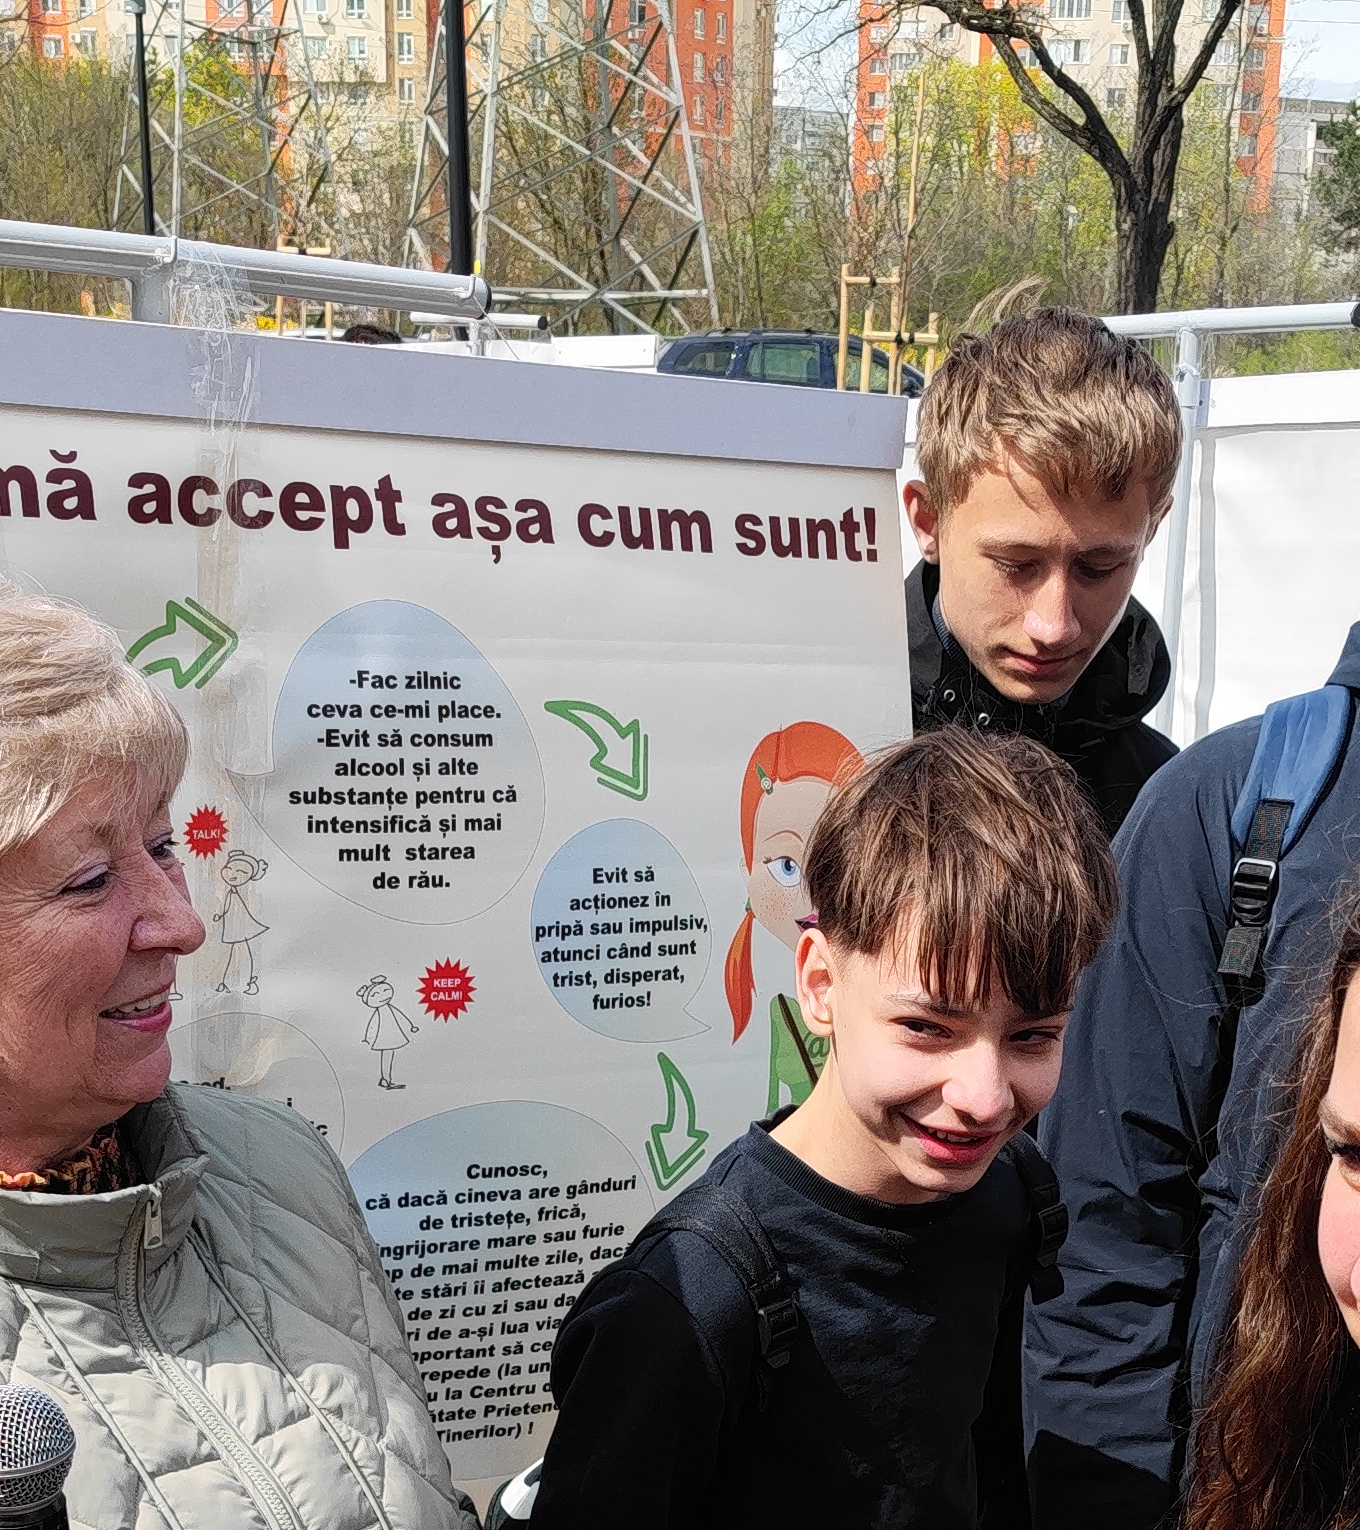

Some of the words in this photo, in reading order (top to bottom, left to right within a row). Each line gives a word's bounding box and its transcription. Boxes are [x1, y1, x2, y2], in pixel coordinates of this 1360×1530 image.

[127, 473, 406, 549] accept
[431, 491, 555, 564] așa
[578, 502, 713, 552] cum
[735, 507, 878, 563] sunt!
[349, 670, 398, 690] -Fac
[405, 671, 462, 690] zilnic
[307, 703, 362, 719] ceva
[370, 701, 431, 719] ce-mi
[438, 700, 502, 723] place.
[317, 729, 370, 748] -Evit
[377, 730, 403, 748] să
[410, 732, 494, 747] consum
[334, 758, 405, 777] alcool
[412, 758, 431, 782] și
[438, 758, 479, 776] alte
[288, 787, 408, 811] substanțe
[416, 786, 485, 809] pentru
[492, 785, 517, 803] că
[192, 829, 220, 839] TALK!
[307, 815, 431, 834] intensifică
[439, 814, 457, 838] și
[464, 813, 502, 831] mai
[339, 844, 391, 862] mult
[405, 844, 476, 861] starea
[372, 872, 400, 890] de
[408, 871, 451, 889] rău.
[592, 867, 628, 884] Evit
[634, 866, 655, 882] să
[569, 894, 650, 915] acționez
[655, 891, 671, 907] în
[535, 920, 584, 942] pripă
[590, 922, 623, 935] sau
[629, 914, 708, 936] impulsiv,
[541, 944, 601, 963] atunci
[606, 941, 652, 960] când
[657, 939, 697, 957] sunt
[433, 978, 461, 988] KEEP
[552, 970, 598, 988] trist,
[604, 965, 685, 987] disperat,
[430, 991, 463, 1001] CALM!
[592, 991, 651, 1010] furios!
[466, 1163, 548, 1180] Cunosc,
[365, 1192, 390, 1211] că
[397, 1189, 448, 1209] dacă
[454, 1186, 522, 1205] cineva
[528, 1184, 560, 1199] are
[566, 1175, 636, 1200] gânduri
[419, 1214, 444, 1231] de
[451, 1208, 531, 1230] tristețe,
[537, 1203, 586, 1221] frică,
[376, 1240, 480, 1260] ngrijorare
[486, 1233, 537, 1249] mare
[542, 1229, 576, 1243] sau
[582, 1223, 625, 1239] furie
[410, 1263, 435, 1278] de
[442, 1259, 478, 1276] mai
[484, 1255, 540, 1273] multe
[545, 1249, 583, 1265] zile,
[420, 1281, 467, 1299] stări
[473, 1280, 485, 1295] îi
[491, 1269, 585, 1293] afectează
[407, 1307, 433, 1321] de
[438, 1304, 456, 1319] zi
[461, 1305, 486, 1317] cu
[491, 1299, 508, 1315] zi
[513, 1298, 548, 1312] sau
[426, 1326, 452, 1341] de
[457, 1320, 494, 1342] a-și
[500, 1320, 529, 1336] lua
[501, 1340, 524, 1356] să
[421, 1365, 491, 1384] repede
[497, 1362, 522, 1381] (la
[444, 1386, 463, 1401] la
[469, 1382, 536, 1400] Centru
[527, 1421, 534, 1435] !
